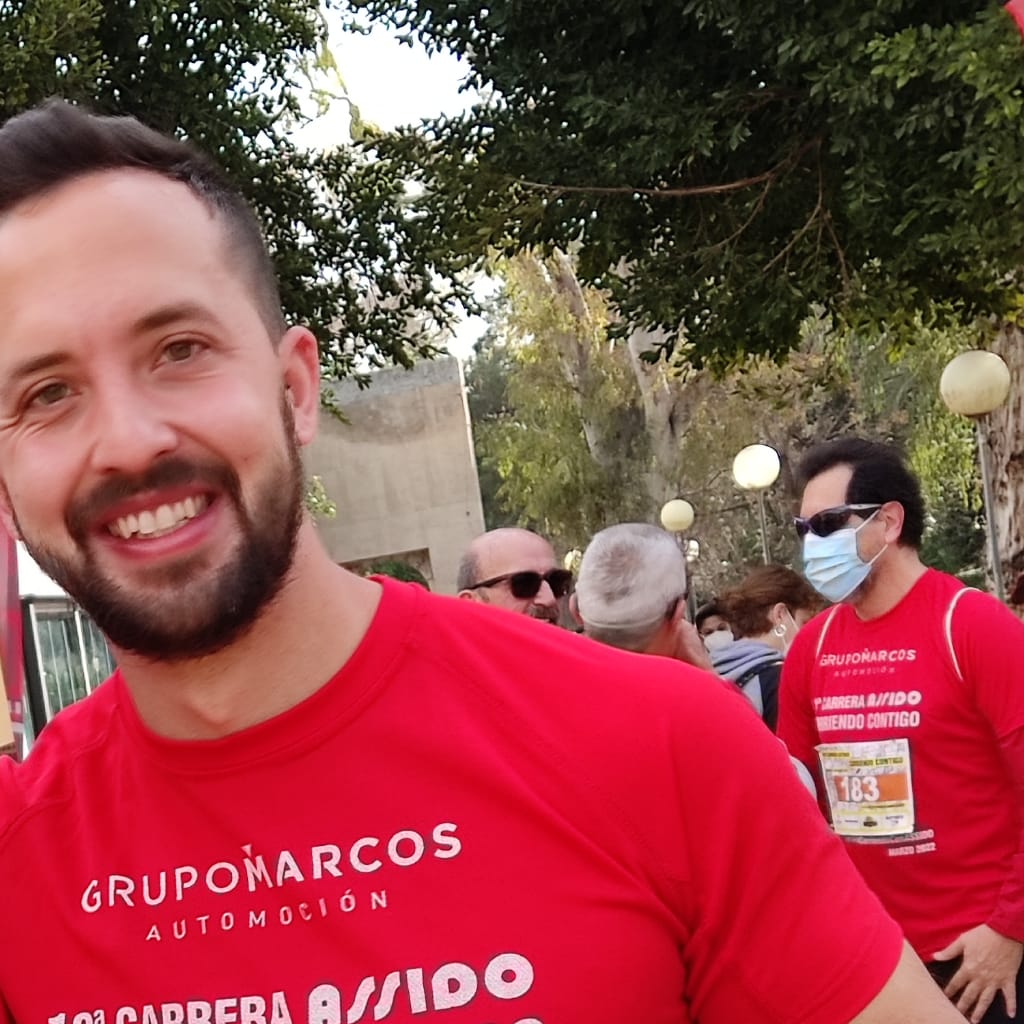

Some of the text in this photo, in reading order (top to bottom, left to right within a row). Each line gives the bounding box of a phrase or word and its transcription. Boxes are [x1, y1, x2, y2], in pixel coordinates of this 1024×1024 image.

[838, 776, 880, 802] 183
[81, 822, 463, 913] GRUPOMARCOS
[146, 889, 388, 942] AUTOMOCIÓN
